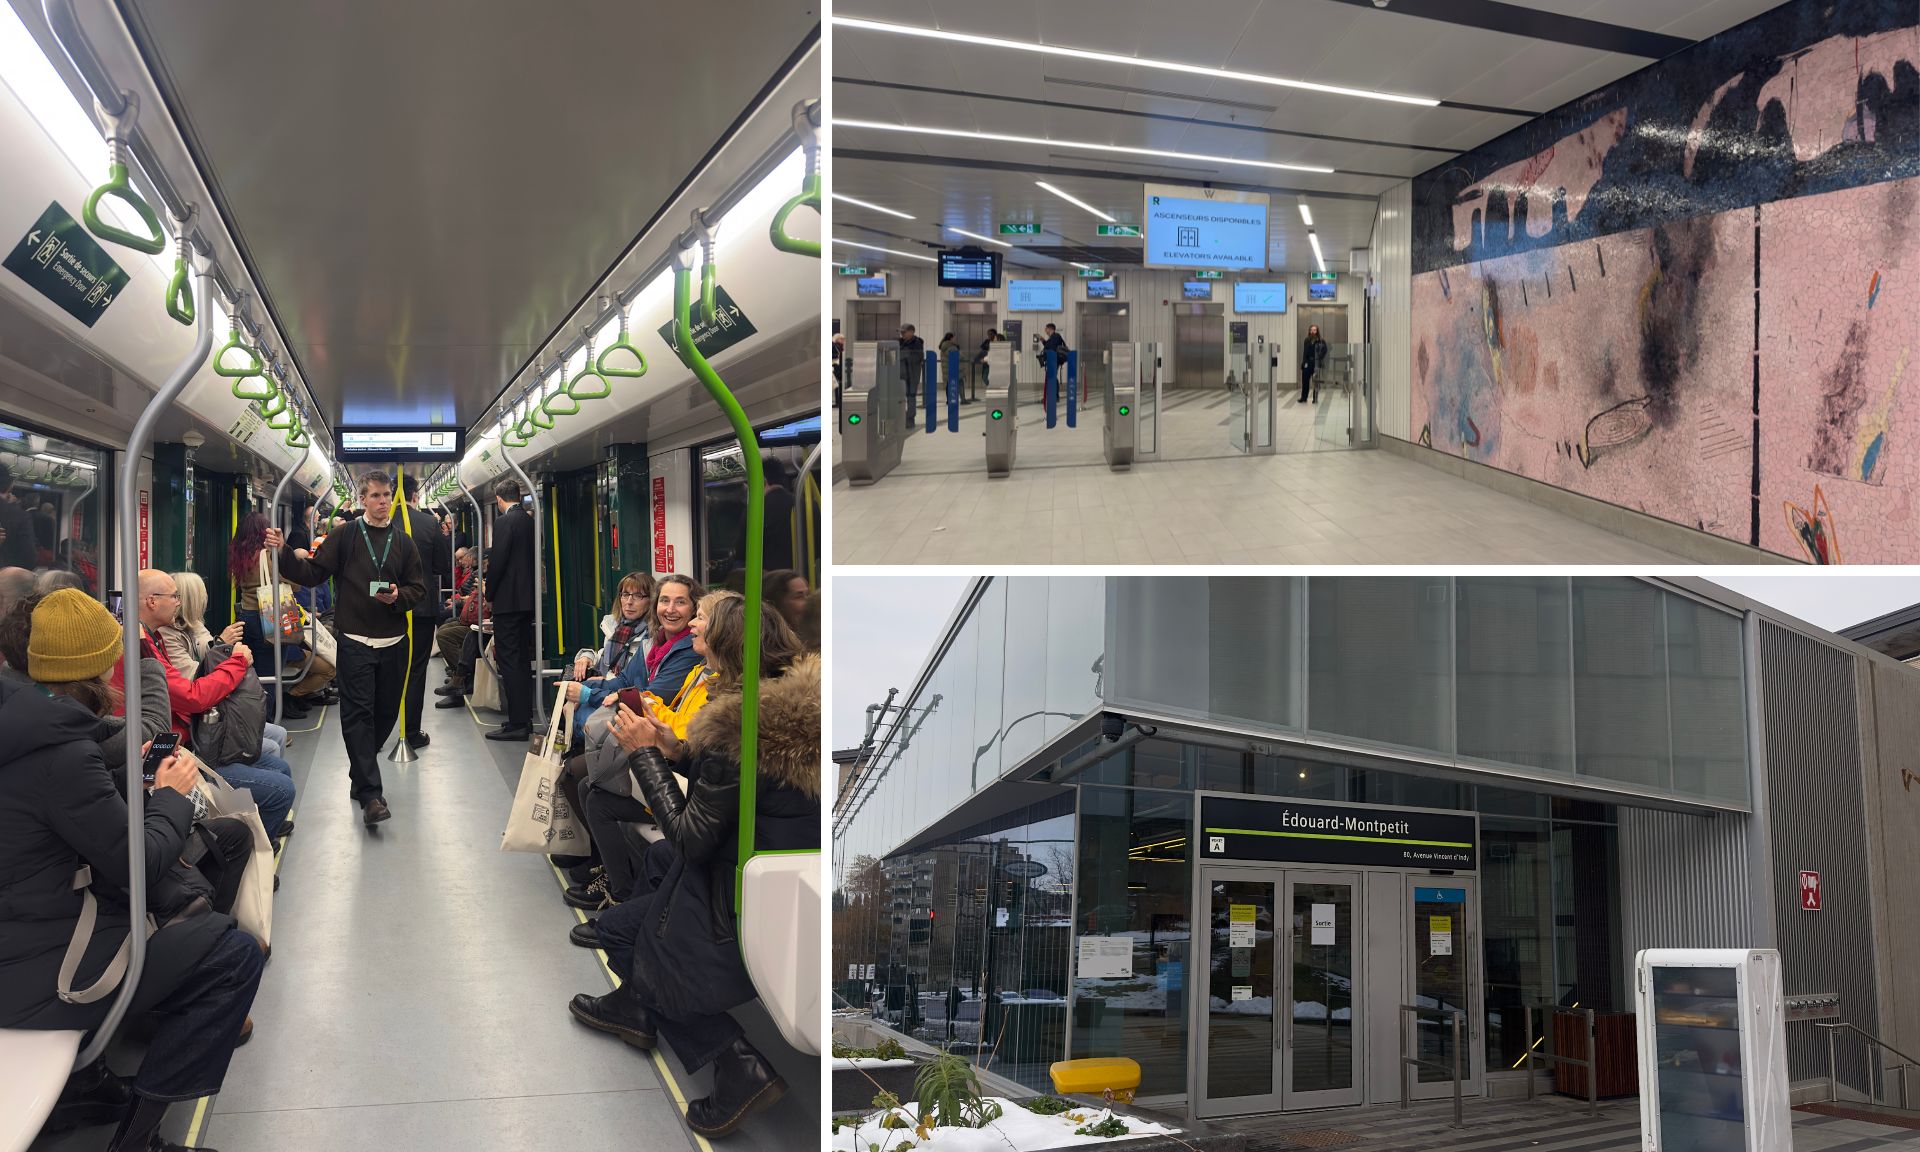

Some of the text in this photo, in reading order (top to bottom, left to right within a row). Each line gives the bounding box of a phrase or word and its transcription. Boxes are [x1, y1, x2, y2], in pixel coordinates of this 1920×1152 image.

[1154, 212, 1262, 225] ASCENSEURS DISPONIBLES
[1163, 251, 1254, 262] ELEVATORS AVAILABLE
[60, 248, 97, 284] Sortie de secours
[52, 261, 87, 292] Emergency Door
[1282, 810, 1409, 836] Édouard-Montpetit
[1213, 843, 1220, 851] A
[1413, 852, 1433, 860] Avenue
[1453, 854, 1470, 862] d'Indy
